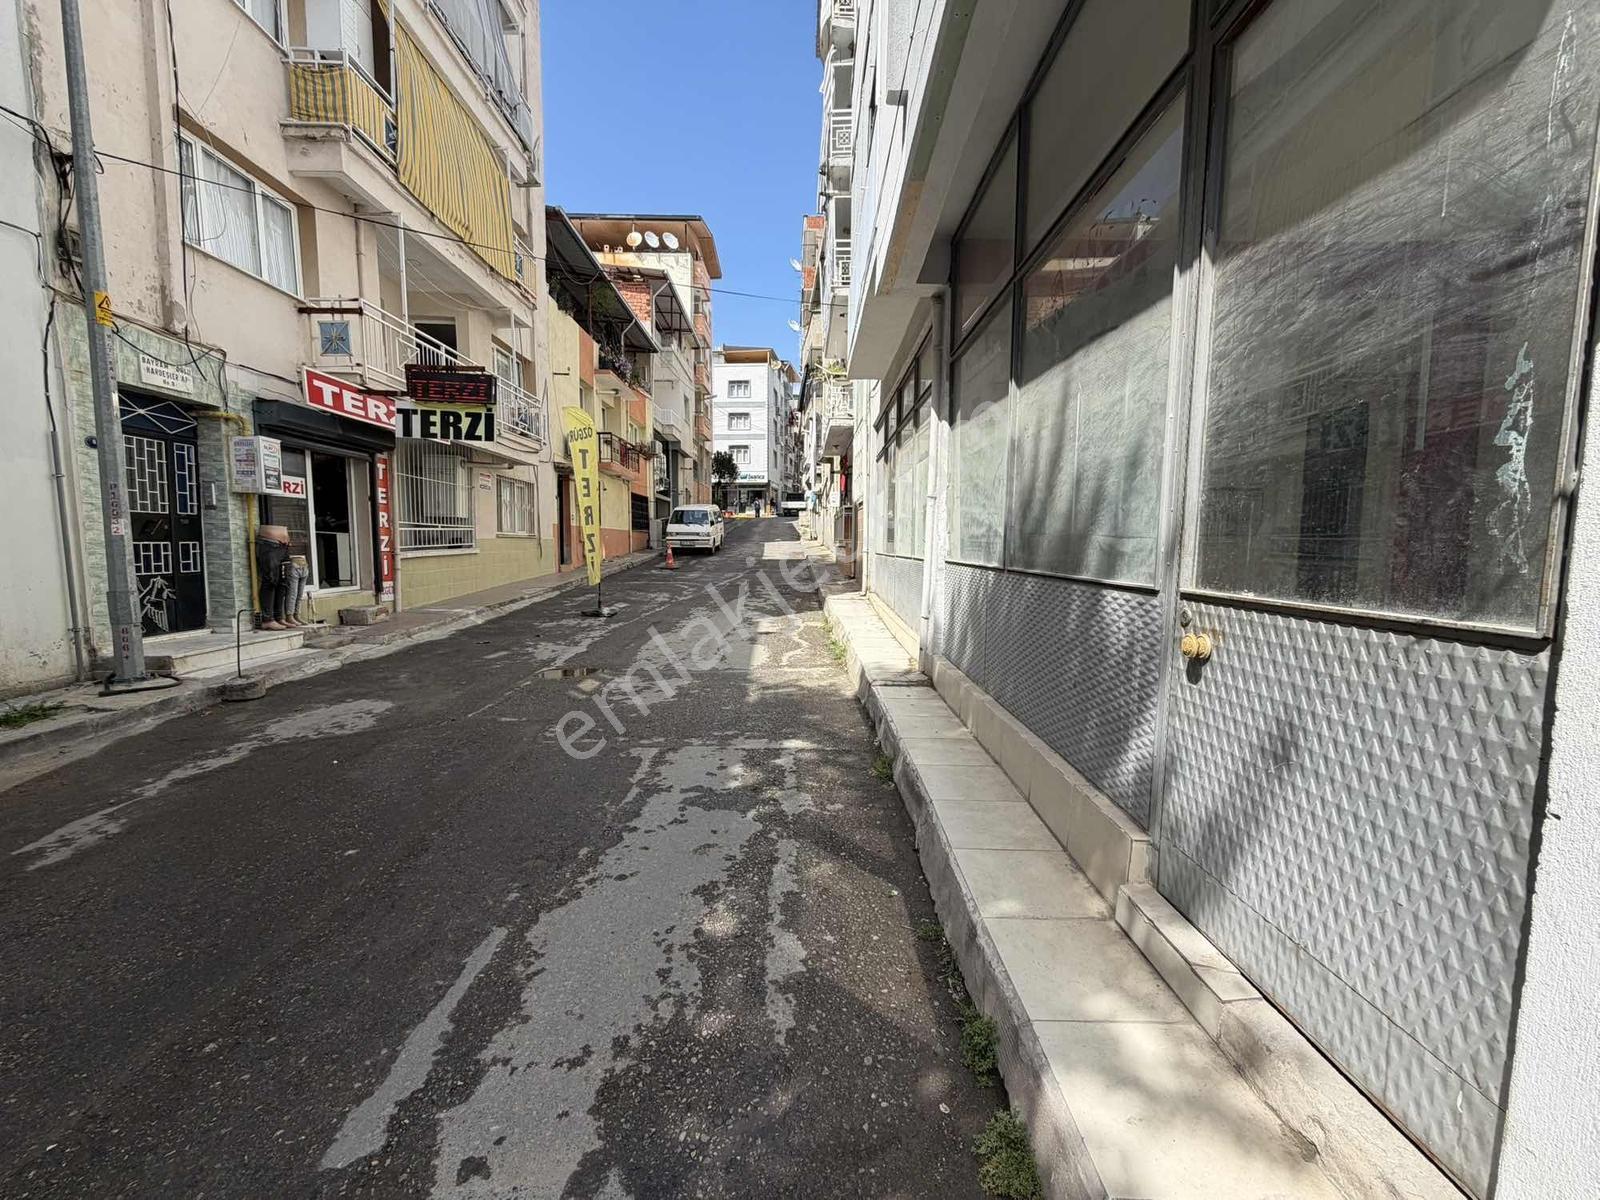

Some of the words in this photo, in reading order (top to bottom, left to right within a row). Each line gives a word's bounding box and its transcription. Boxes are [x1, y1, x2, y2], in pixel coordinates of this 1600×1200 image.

[313, 378, 395, 425] TER
[396, 407, 495, 442] TERZİ
[282, 480, 305, 495] RZİ
[377, 463, 391, 576] TERZİ
